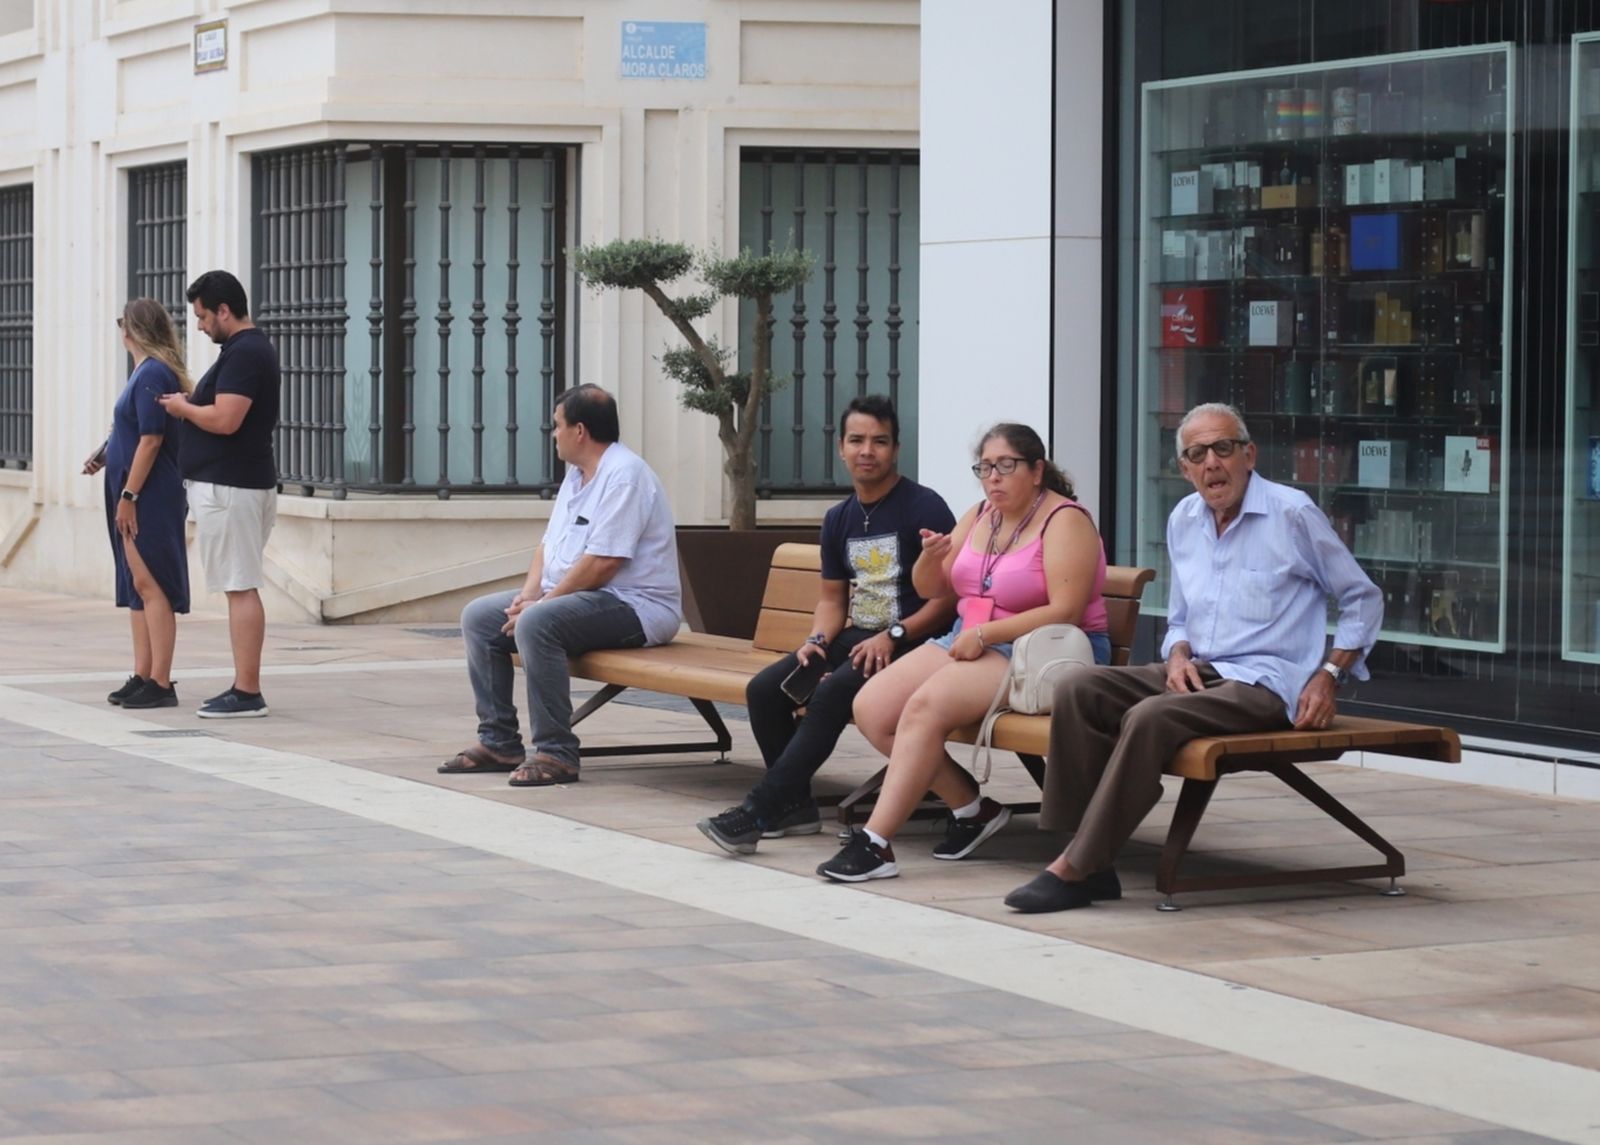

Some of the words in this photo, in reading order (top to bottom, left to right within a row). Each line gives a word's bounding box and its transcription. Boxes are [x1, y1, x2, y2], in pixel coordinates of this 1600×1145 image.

[622, 45, 676, 59] ALCALDE
[622, 62, 656, 76] MORA
[658, 63, 705, 77] CLAROS
[1174, 175, 1195, 187] LOEWE
[1251, 304, 1276, 316] LOEWE
[1361, 446, 1388, 456] LOEWE
